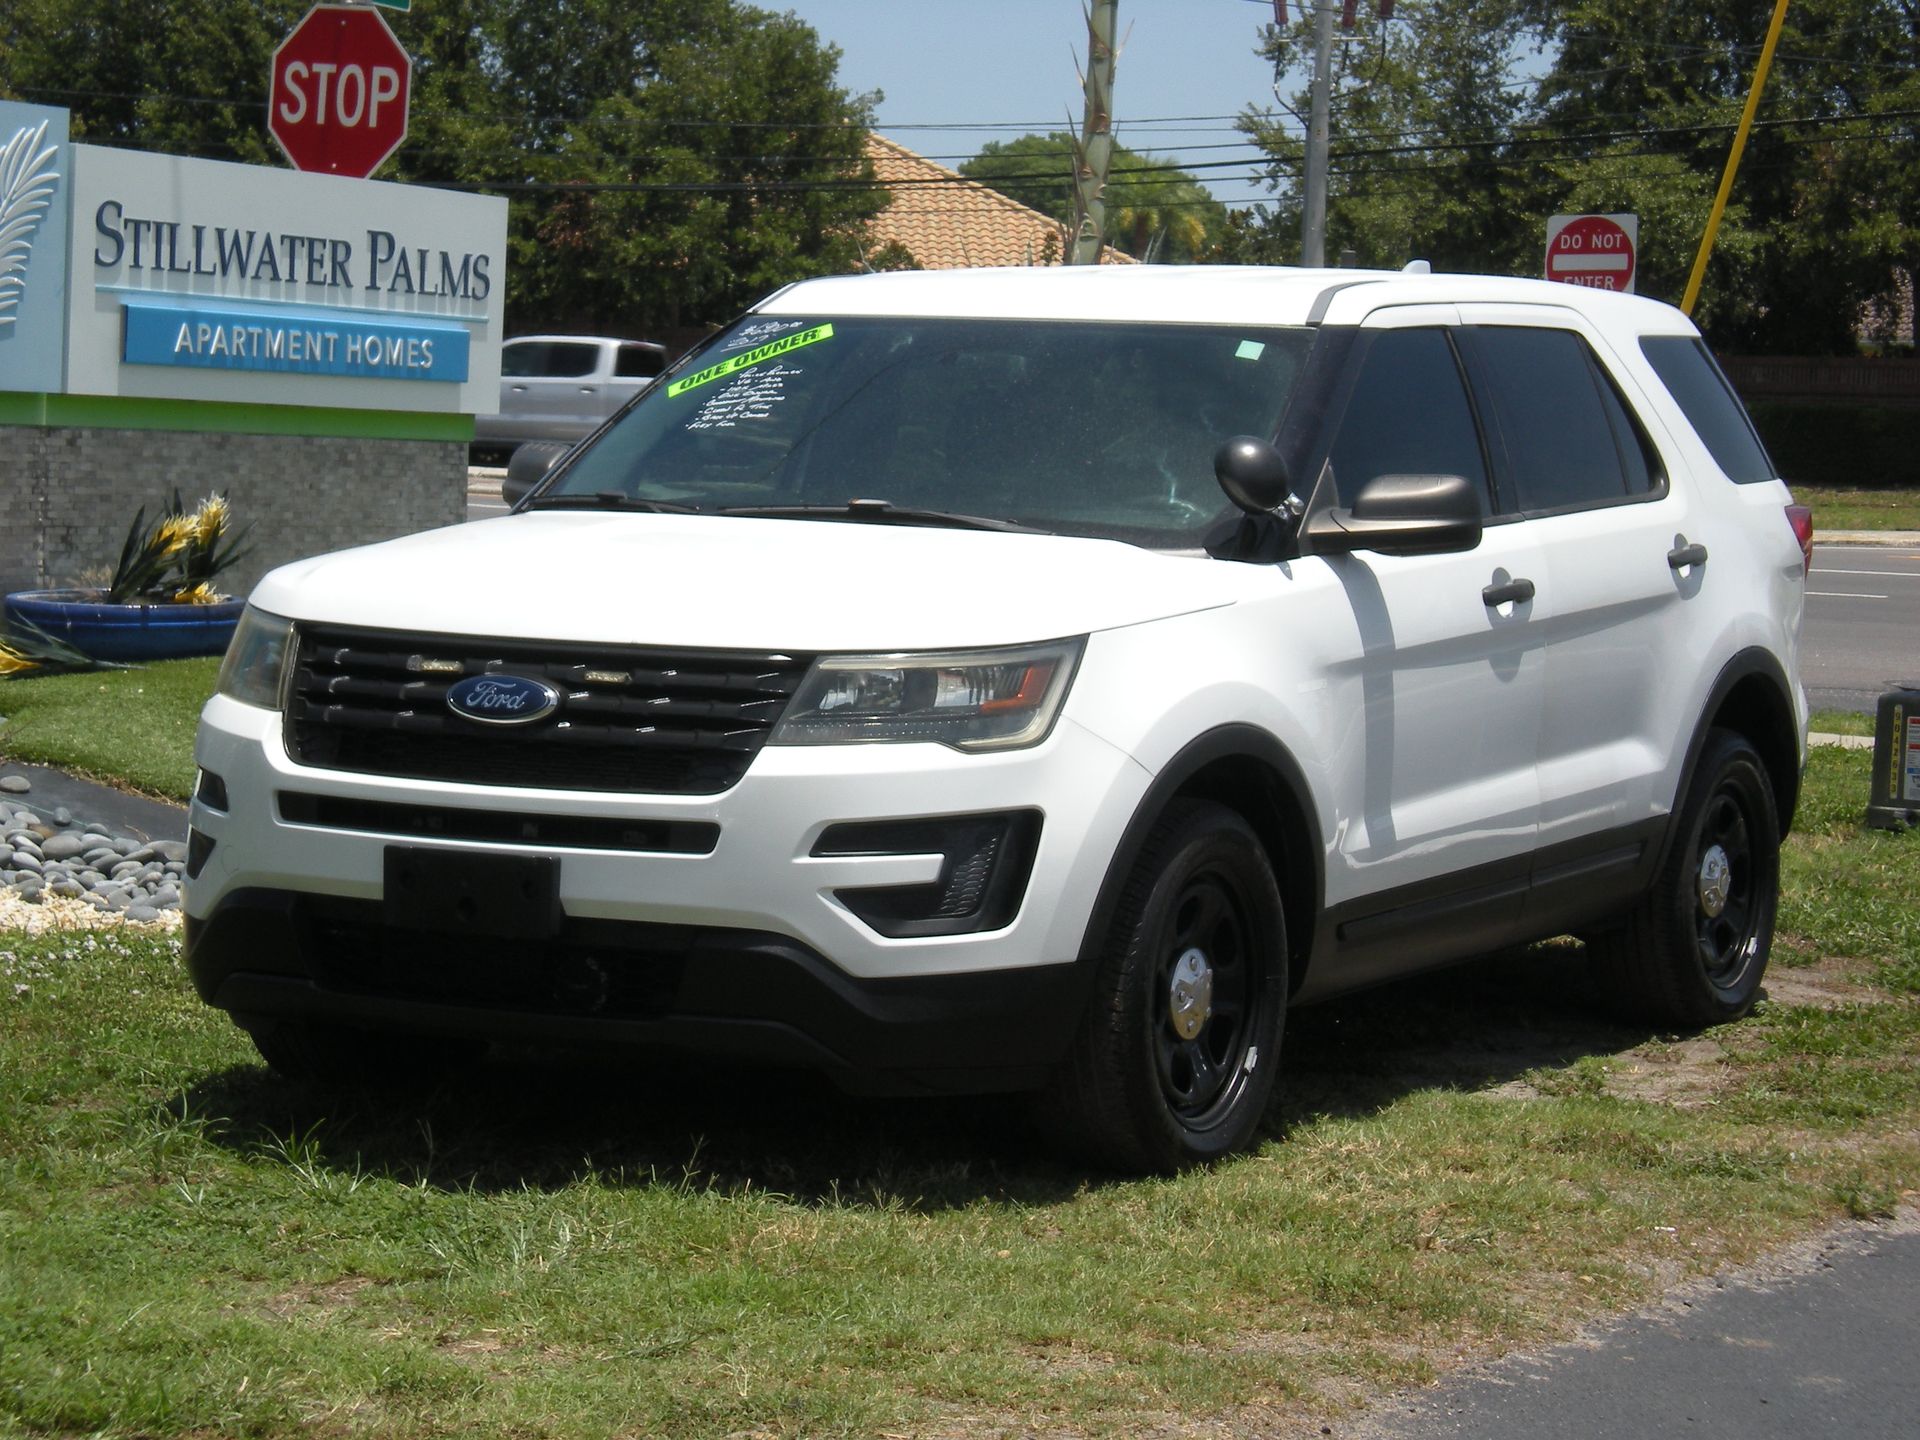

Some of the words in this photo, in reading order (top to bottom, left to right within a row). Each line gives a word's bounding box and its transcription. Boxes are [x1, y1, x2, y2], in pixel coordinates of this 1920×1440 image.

[280, 61, 400, 129] STOP
[94, 200, 353, 289] STILLWATER
[365, 229, 491, 301] PALMS
[1560, 234, 1582, 249] DO
[1592, 233, 1623, 249] NOT
[174, 322, 339, 363] APARTMENT
[345, 334, 434, 370] HOMES
[680, 362, 730, 390] ONE
[733, 328, 821, 368] OWNER
[466, 681, 529, 709] Ford
